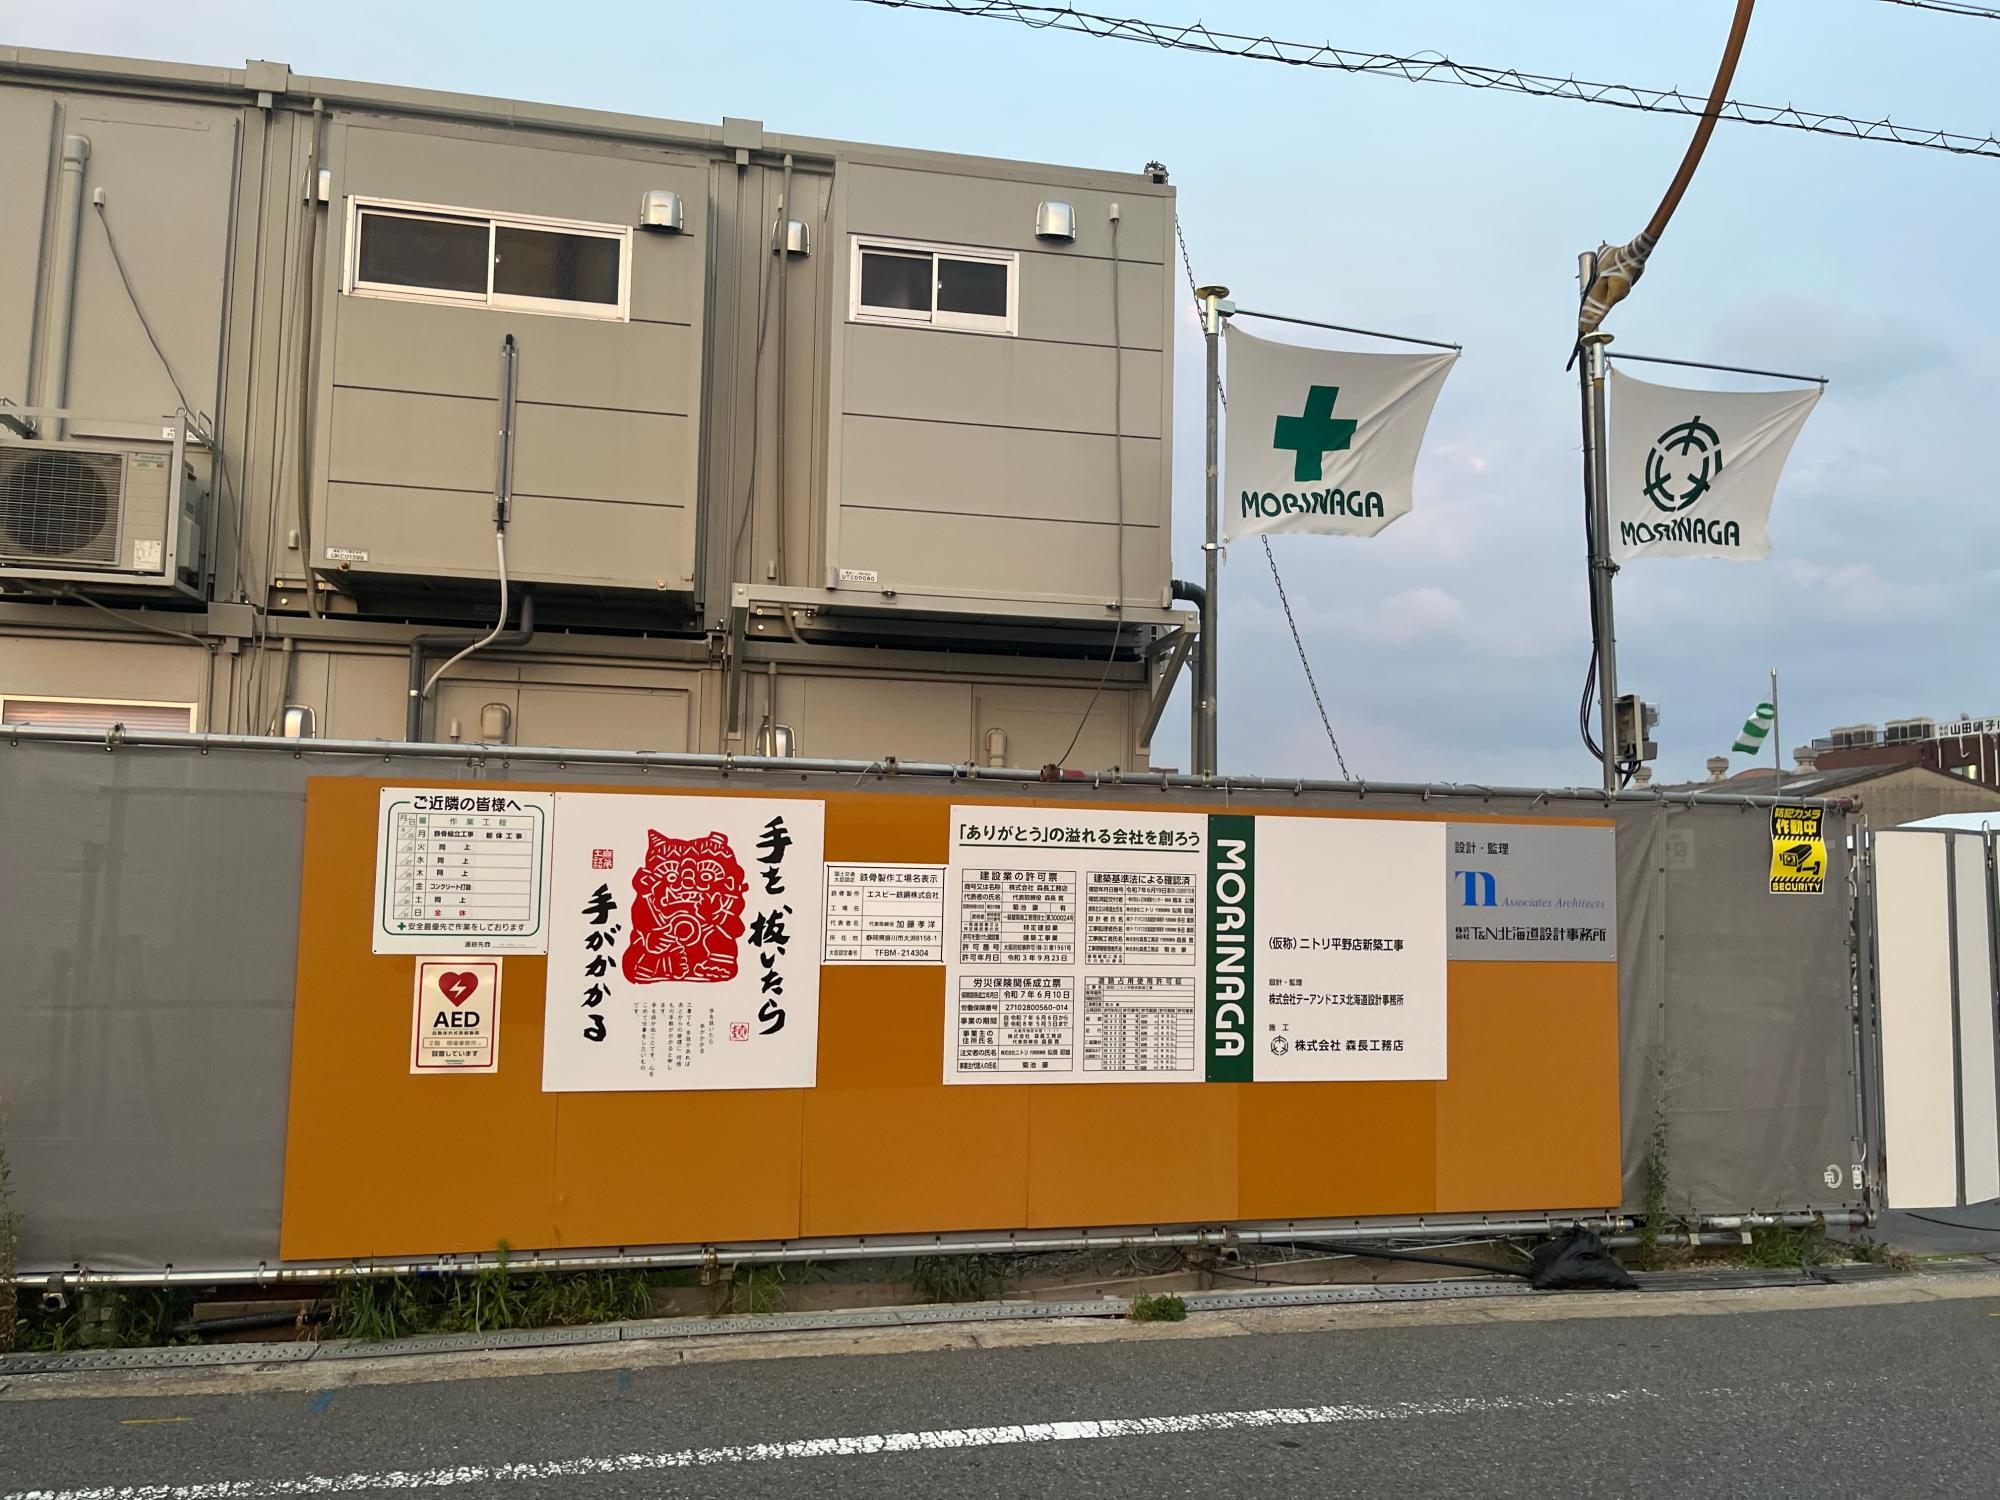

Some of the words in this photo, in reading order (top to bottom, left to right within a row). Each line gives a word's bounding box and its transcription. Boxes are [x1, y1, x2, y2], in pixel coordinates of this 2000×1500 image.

[413, 795, 522, 812] ご近隣の皆様へ
[1775, 807, 1822, 820] 防犯カメラ
[1775, 818, 1817, 836] 作動中
[959, 824, 1201, 846] 「ありがとう」の溢れる会社を創ろう
[1454, 841, 1509, 855] 設計・監理
[859, 873, 938, 884] 鉄骨製作工場名表示
[980, 871, 1058, 882] 建設業の許可票
[1093, 873, 1190, 885] 建築基準法による確認済
[1772, 882, 1821, 892] SECURITY
[1501, 897, 1552, 908] Associates
[1554, 897, 1605, 909] Architects
[408, 922, 526, 932] 安全最優先で作業をしております
[747, 815, 794, 1036] 手を抜いたら
[874, 949, 929, 957] TFBM-214304
[1215, 838, 1247, 1057] MORINAGA
[581, 883, 622, 1042] 手がかかる
[973, 978, 1061, 988] 労災保険関係成立票
[1003, 990, 1070, 999] 令和7年6月10日
[1268, 993, 1404, 1006] 株式会社テーアンドエヌ北海道設計事務所
[433, 1011, 481, 1028] AED
[961, 1017, 998, 1025] 事業の期間
[1294, 1039, 1341, 1051] 株式会社
[1345, 1039, 1404, 1051] 森長工務店
